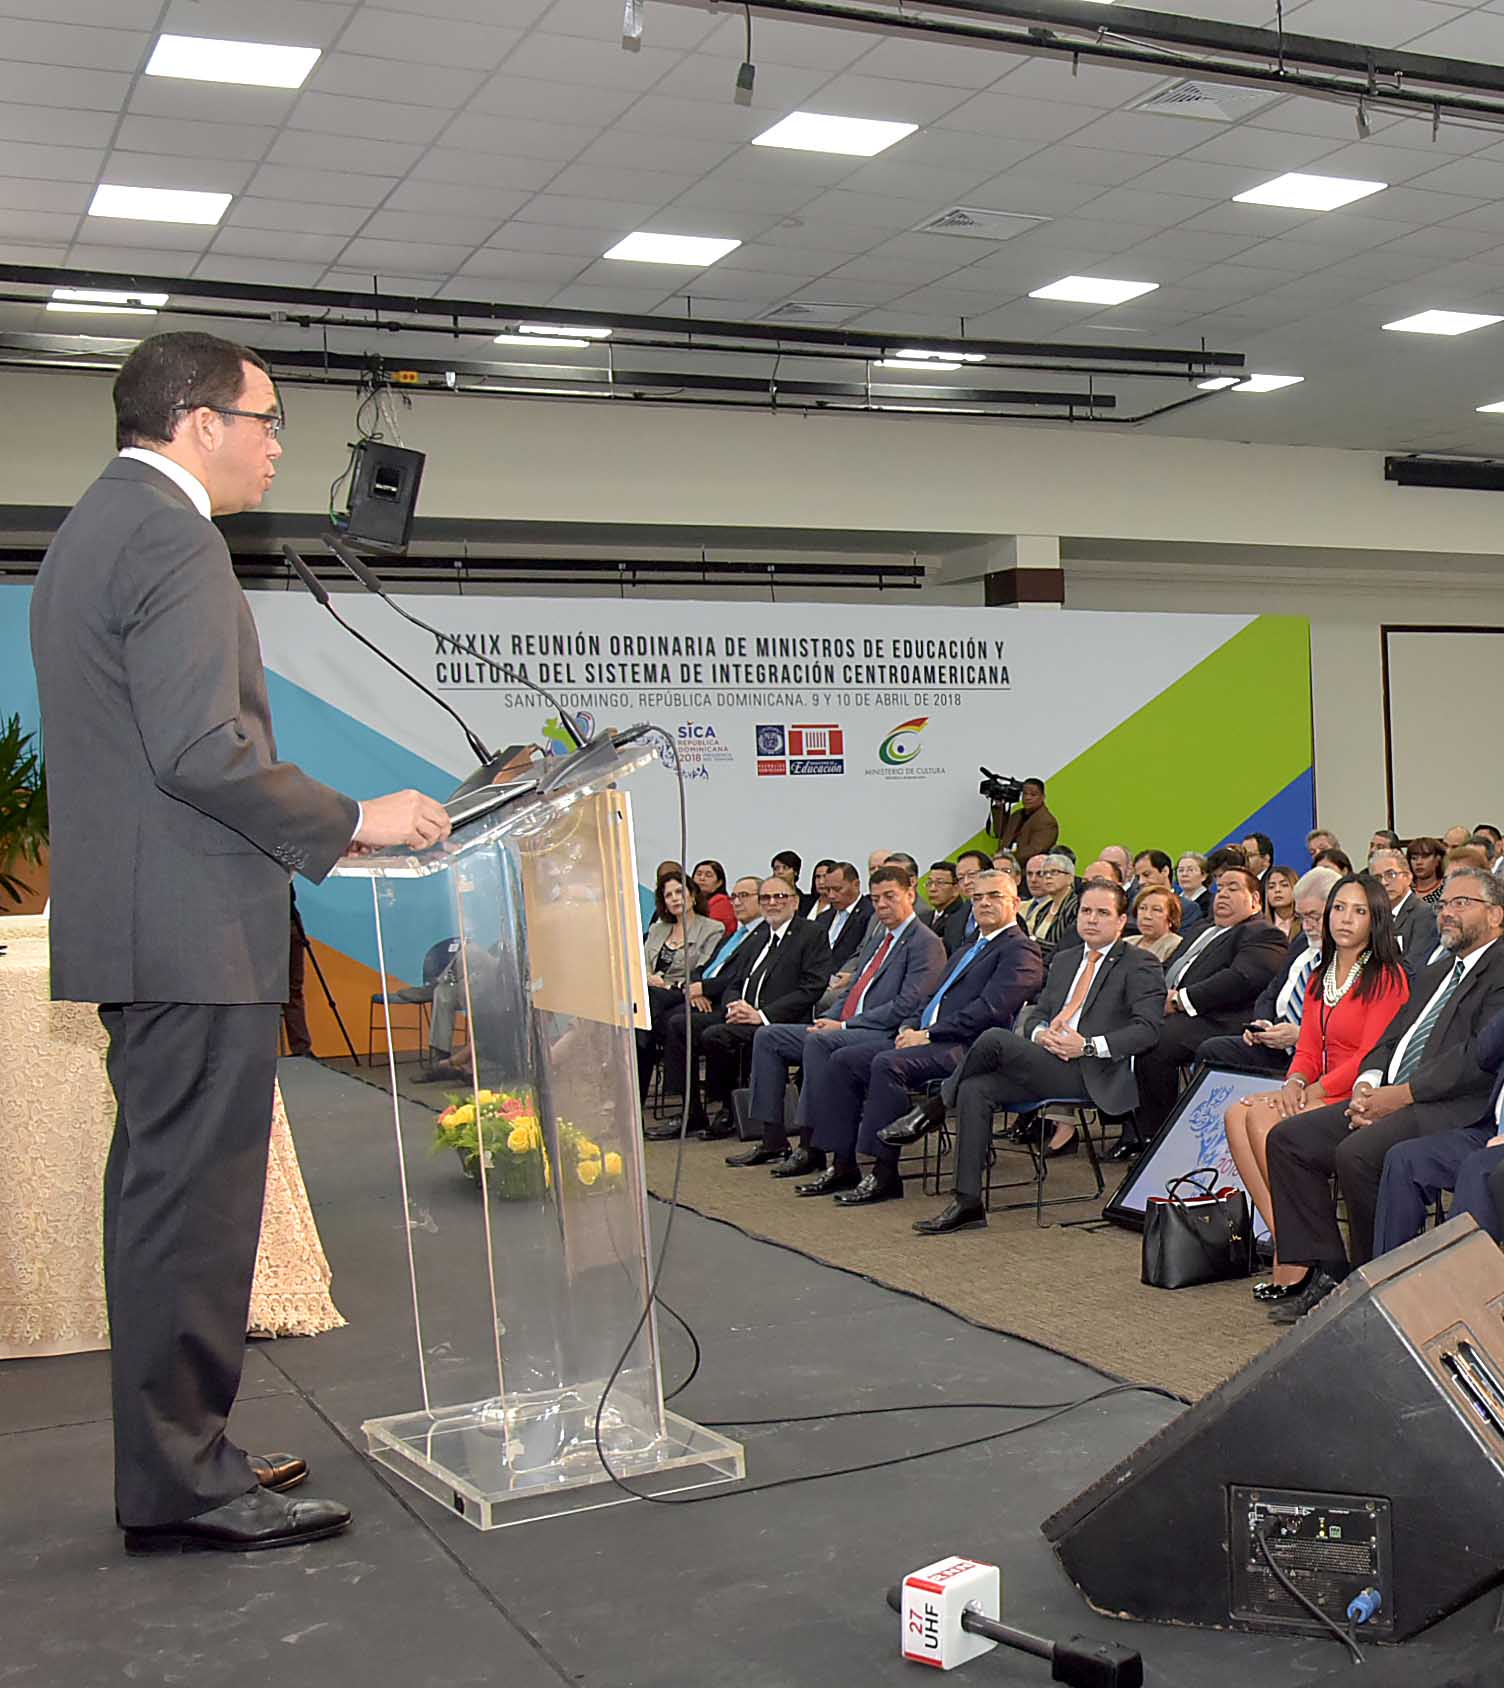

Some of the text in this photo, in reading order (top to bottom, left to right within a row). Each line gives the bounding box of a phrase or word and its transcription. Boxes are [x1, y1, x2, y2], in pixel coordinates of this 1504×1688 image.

[435, 631, 1004, 659] XXXIX REUNIÓN ORDINARIA DE MINISTROS DE EDUCACIÓN Y
[436, 661, 1010, 684] CULTURA DEL SISTEMA DE INTEGRACIÓN CENTROAMERICANA
[505, 693, 553, 708] SANTO
[560, 693, 634, 709] DOMINGO,
[639, 691, 712, 707] REPÚBLICA
[812, 693, 819, 706] 9
[824, 693, 832, 706] Y
[838, 693, 850, 706] 10
[855, 693, 871, 706] DE
[876, 693, 909, 706] ABRIL
[915, 693, 929, 706] DE
[934, 693, 961, 706] 2018
[677, 721, 716, 738] SICA
[679, 753, 701, 762] 2018
[791, 761, 842, 774] Educación
[909, 1609, 923, 1634] 27
[925, 1602, 939, 1650] UHF
